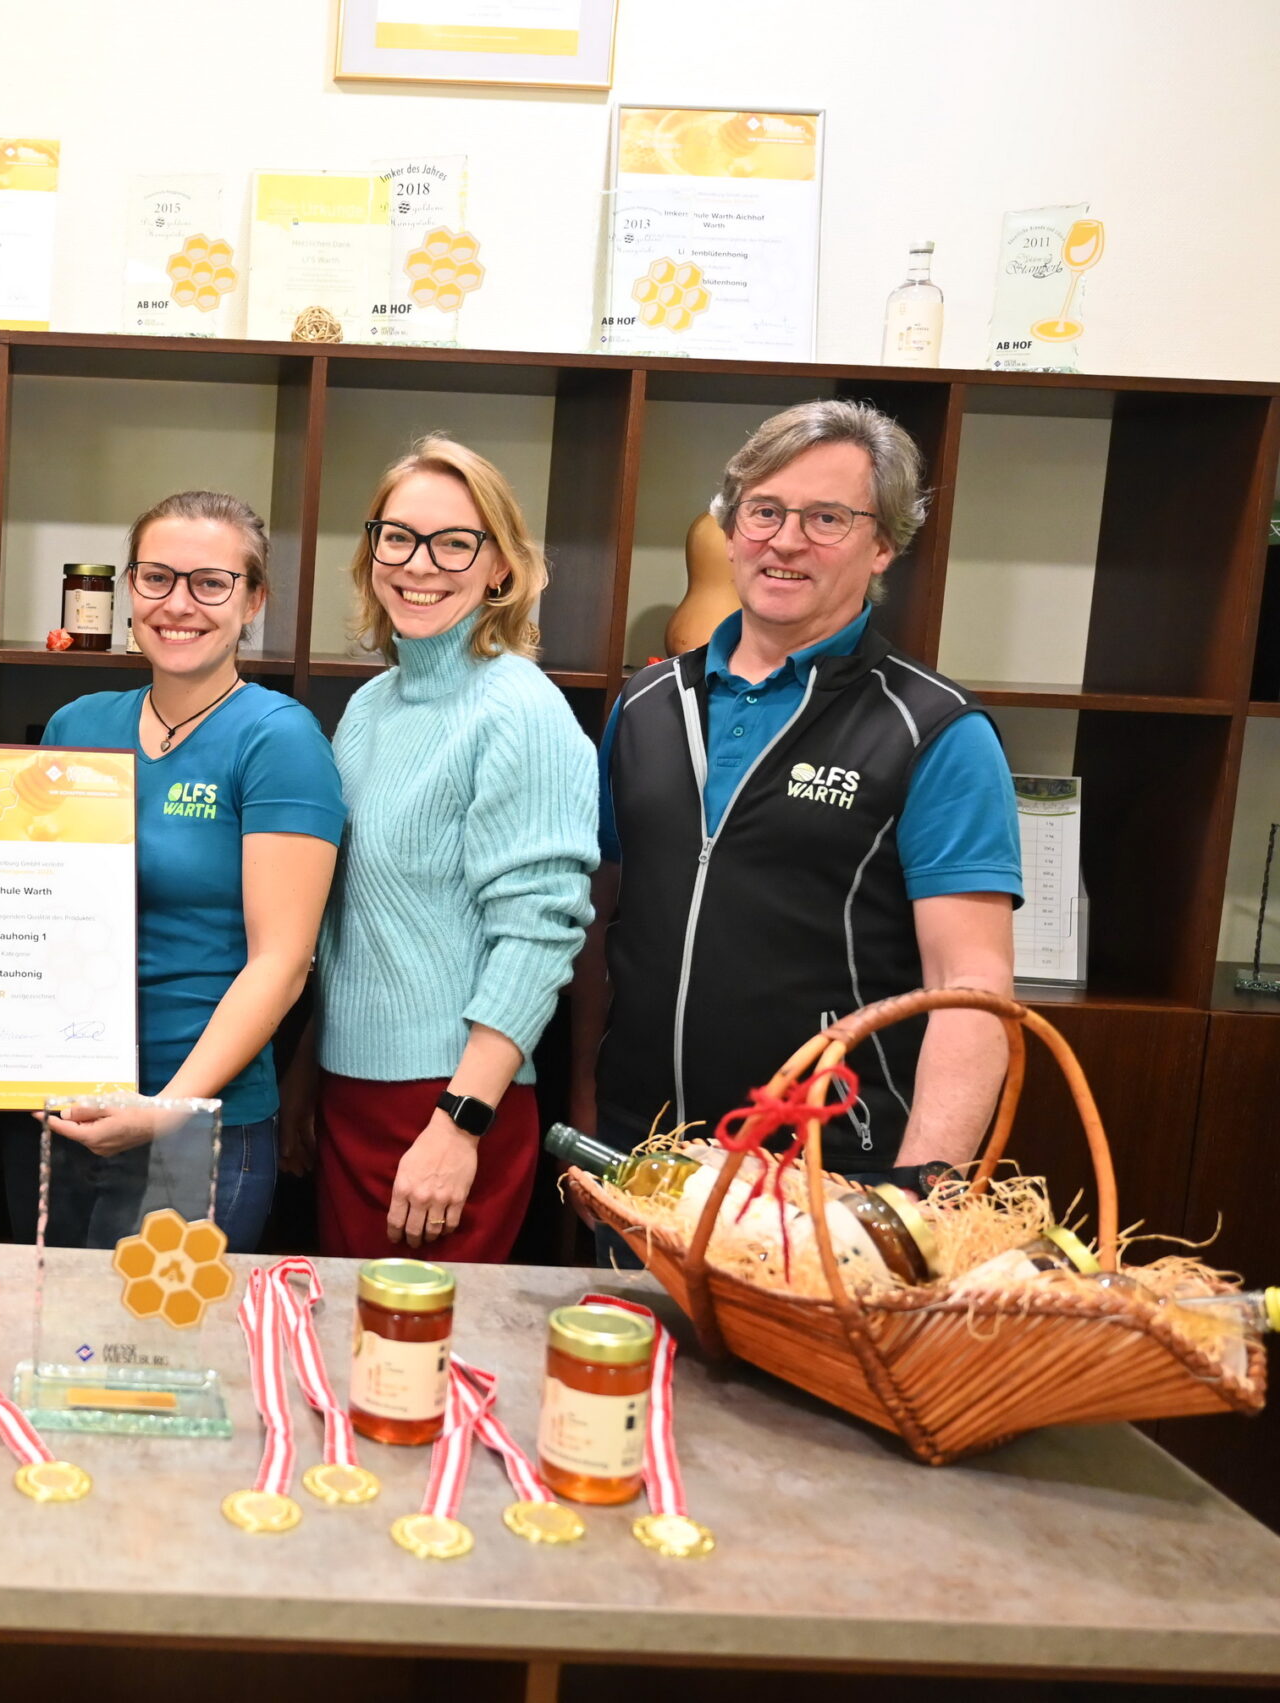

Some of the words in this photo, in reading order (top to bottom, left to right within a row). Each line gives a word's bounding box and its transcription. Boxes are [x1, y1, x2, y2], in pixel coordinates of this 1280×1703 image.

[379, 167, 404, 183] Imker
[407, 163, 420, 174] des
[421, 163, 448, 181] Jahres
[396, 182, 430, 196] 2018
[154, 202, 181, 214] 2015
[623, 218, 651, 229] 2013
[1022, 236, 1050, 248] 2011
[136, 300, 150, 309] AB
[151, 300, 170, 309] HOF
[371, 304, 387, 314] AB
[390, 304, 413, 314] HOF
[601, 316, 615, 326] AB
[616, 316, 637, 326] HOF
[996, 341, 1010, 350] AB
[1012, 340, 1032, 350] HOF
[812, 766, 860, 792] LFS
[181, 782, 218, 804] LFS
[787, 780, 855, 810] WARTH
[163, 801, 217, 820] WARTH
[21, 860, 40, 868] GmbH
[23, 886, 53, 896] Warth
[26, 913, 51, 921] Qualität
[42, 932, 47, 941] 1
[1, 950, 31, 958] Kategorie
[102, 1344, 137, 1354] MESSE
[102, 1354, 169, 1366] WIESELBURG
